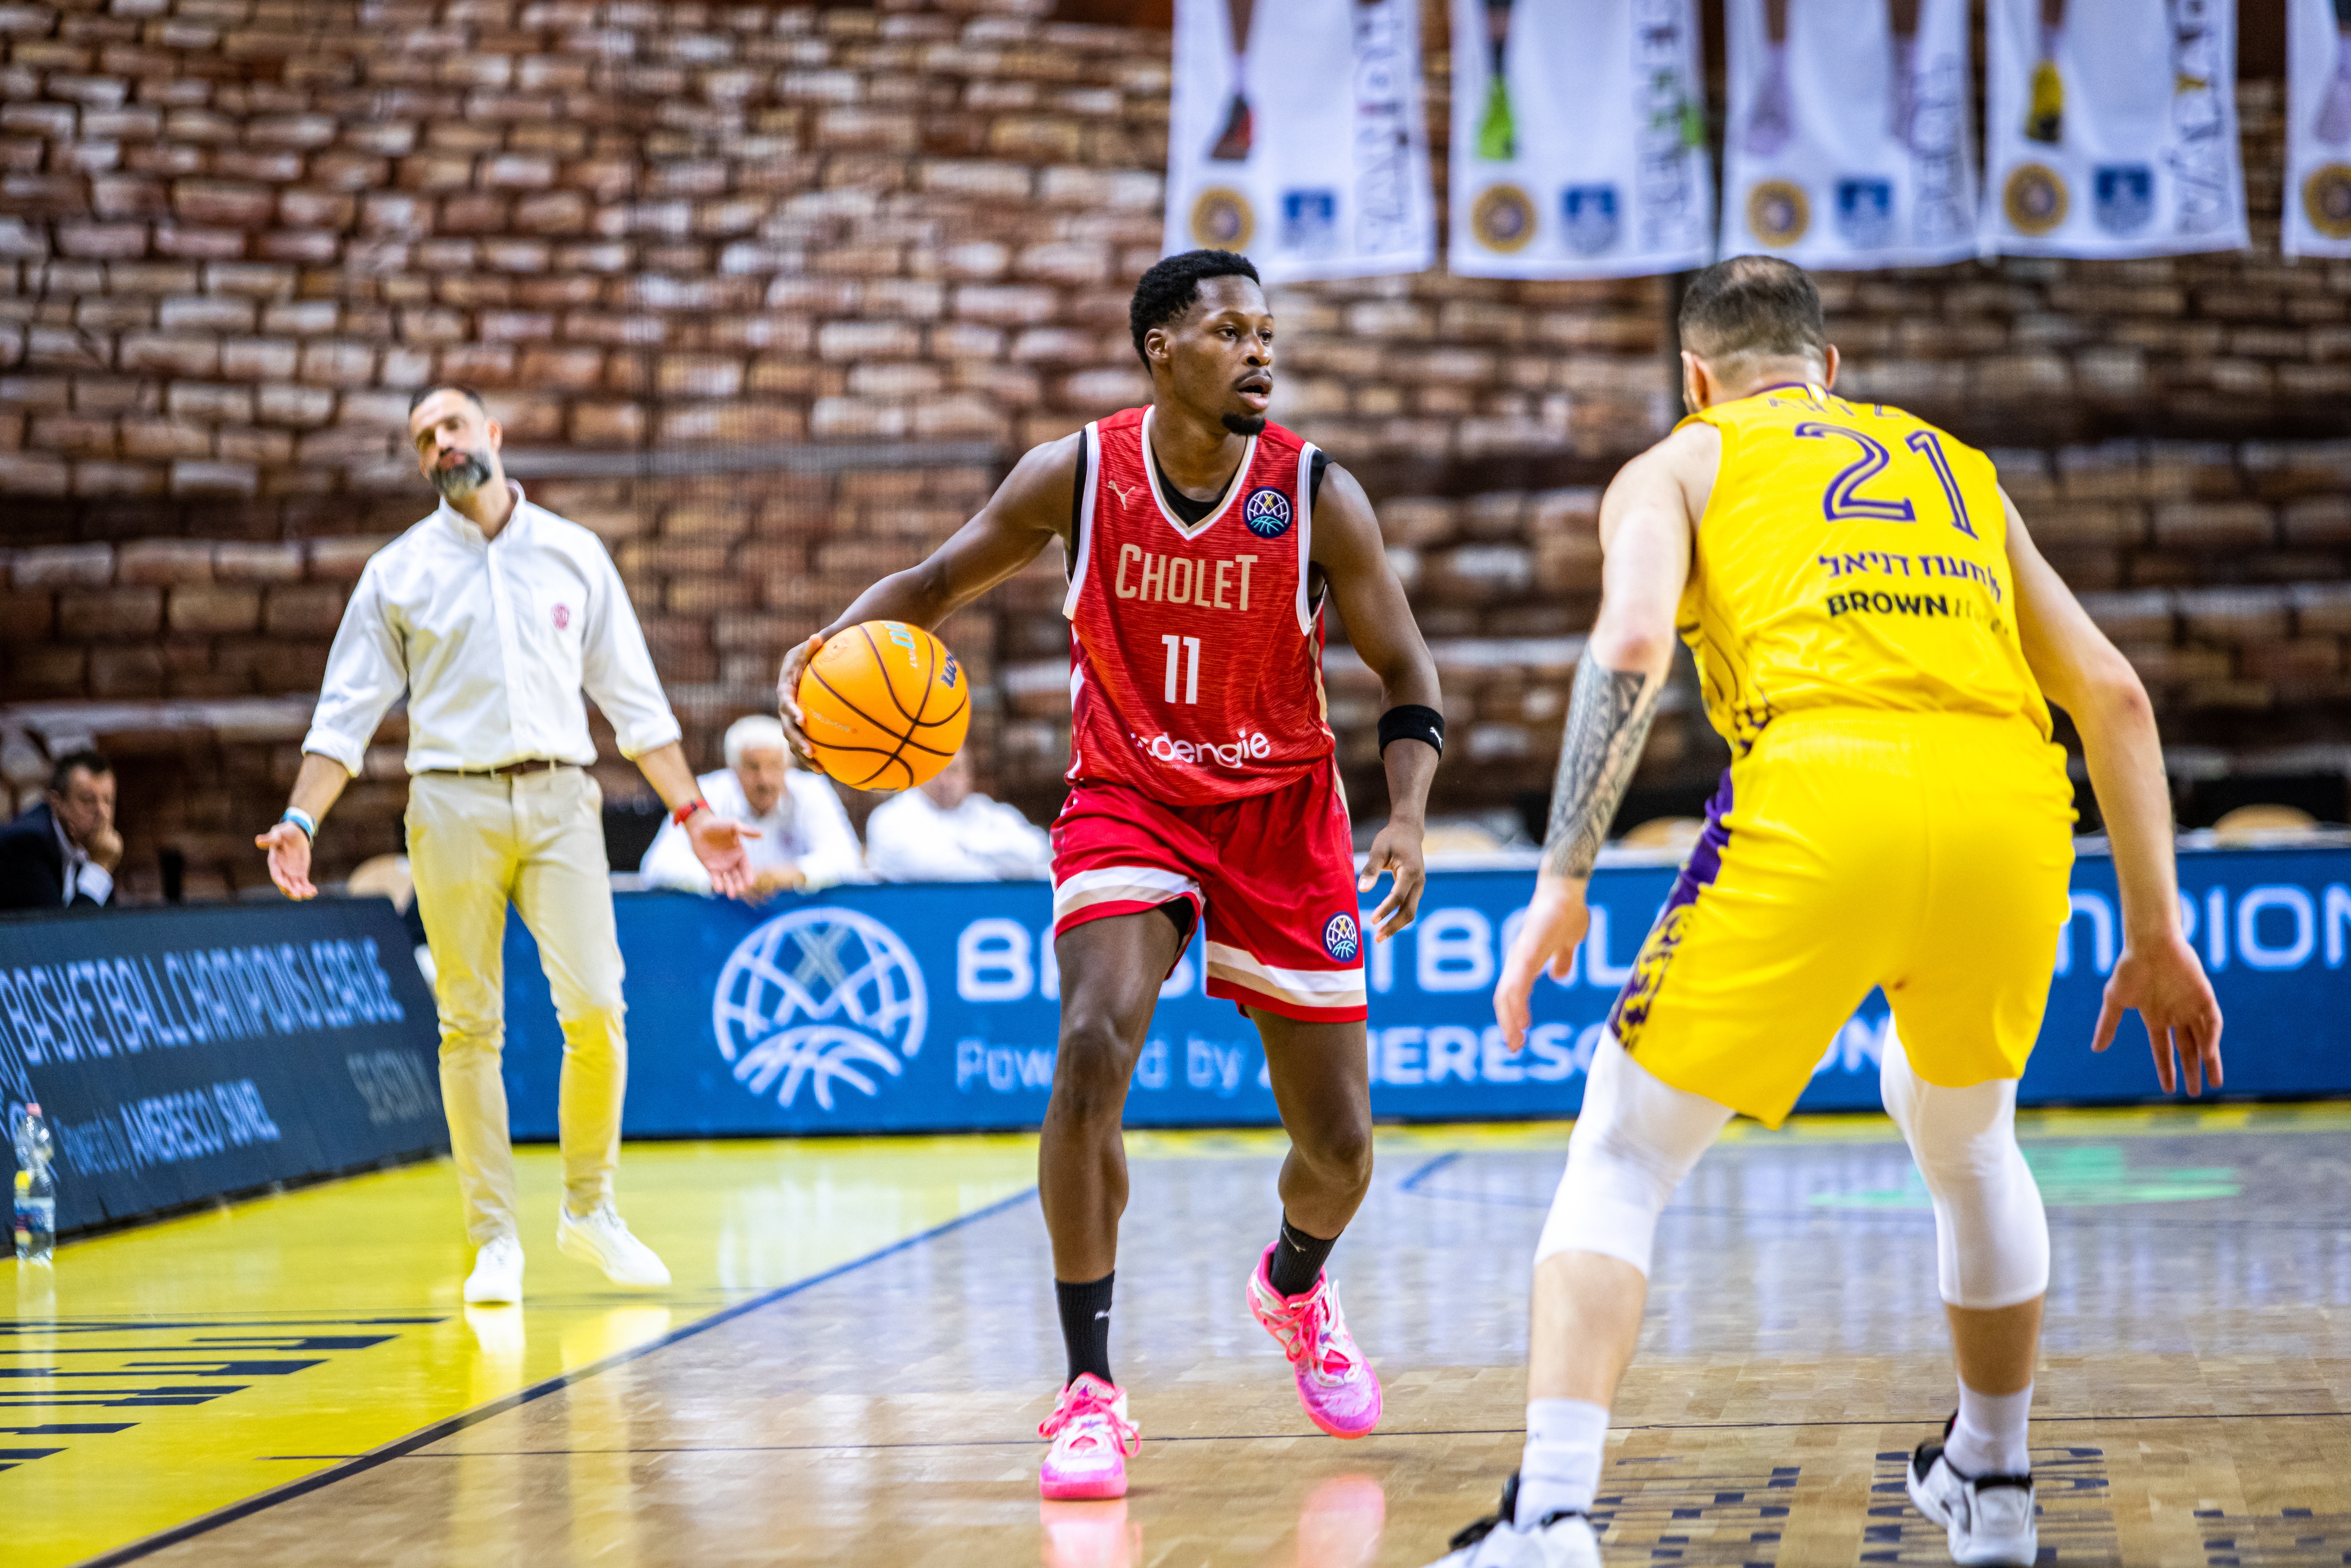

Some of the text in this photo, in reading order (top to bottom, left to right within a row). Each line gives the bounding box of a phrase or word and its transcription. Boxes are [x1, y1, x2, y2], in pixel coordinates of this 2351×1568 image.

[1794, 422, 1979, 541] 21
[1115, 543, 1258, 611] CHOLET
[1818, 551, 1910, 577] דניאל
[1826, 590, 1949, 618] BROWN
[1161, 635, 1200, 704] 11
[0, 936, 404, 1066] BASKETBALL CHAMPIONS LEAGUE
[1186, 1039, 1246, 1098] by
[119, 1089, 225, 1168] AMERESCO
